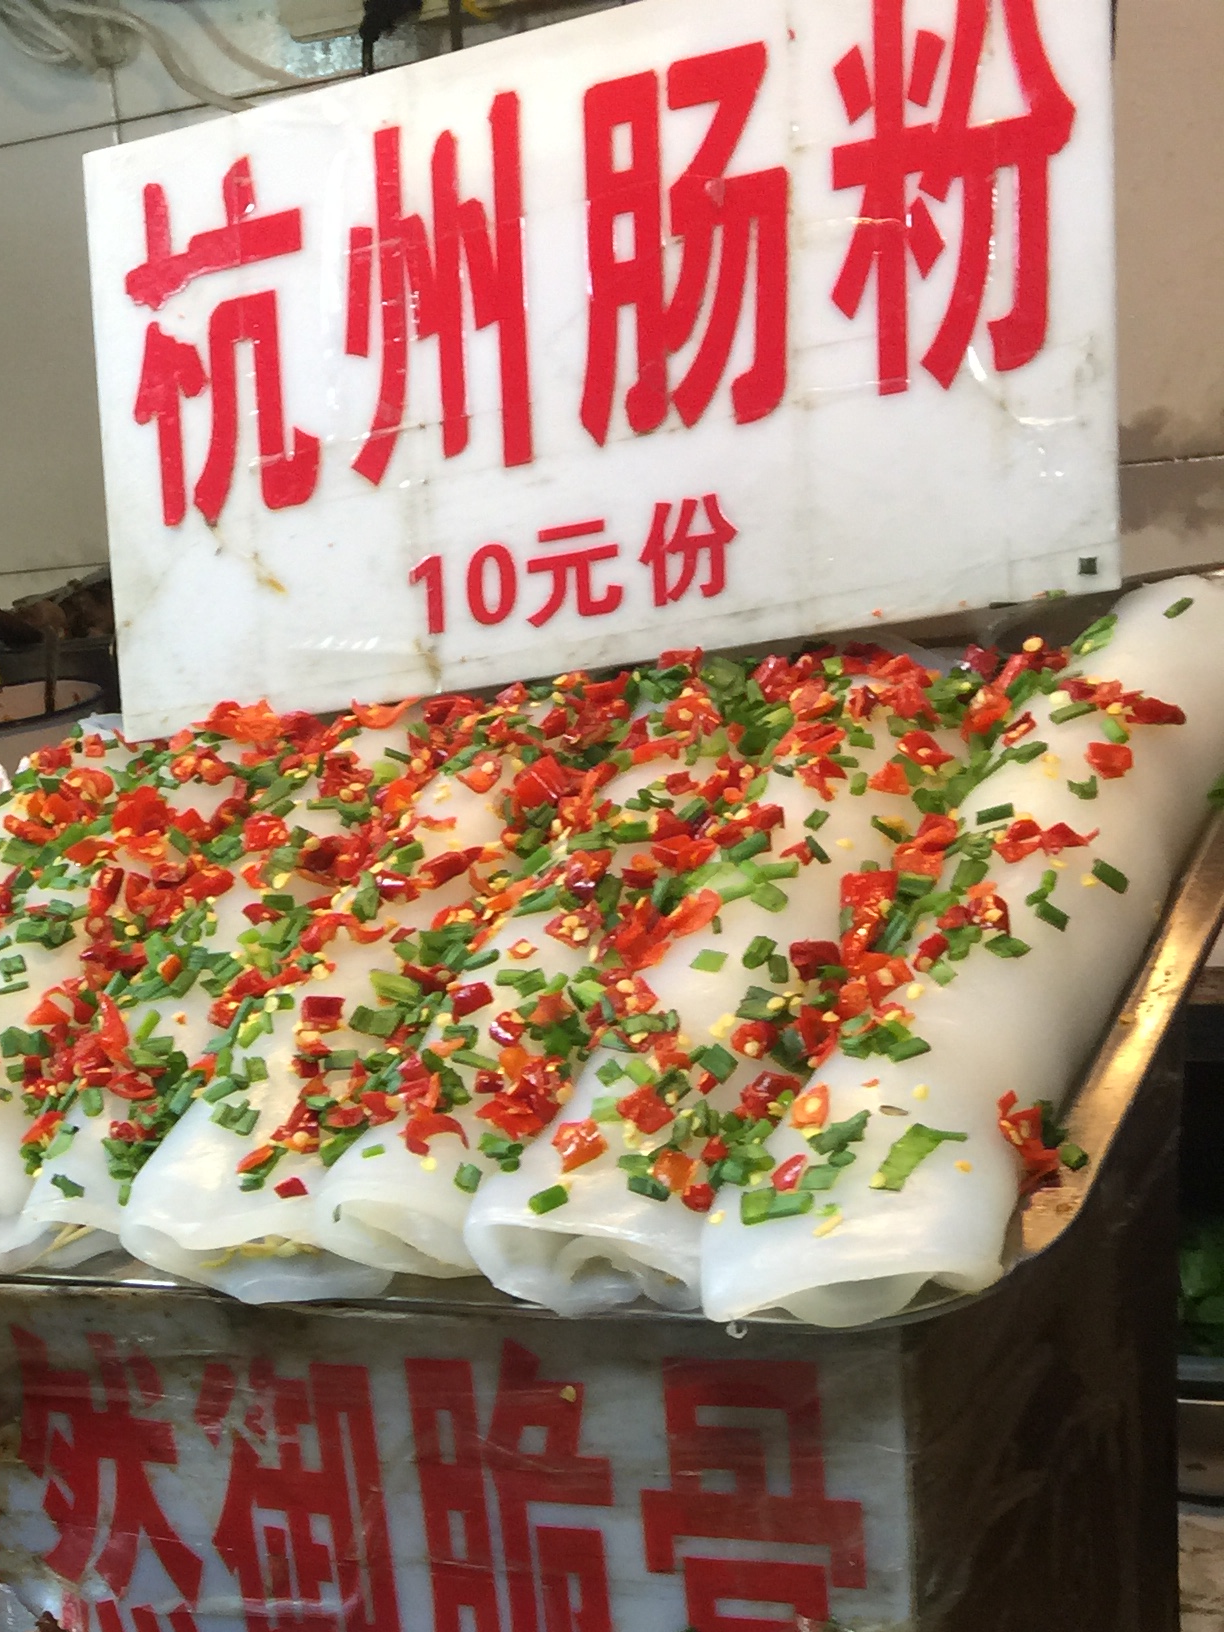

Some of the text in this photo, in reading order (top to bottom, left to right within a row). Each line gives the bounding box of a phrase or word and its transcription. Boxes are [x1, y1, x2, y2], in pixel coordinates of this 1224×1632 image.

[125, 0, 1076, 529] 杭州肠粉
[409, 493, 739, 635] 10元份
